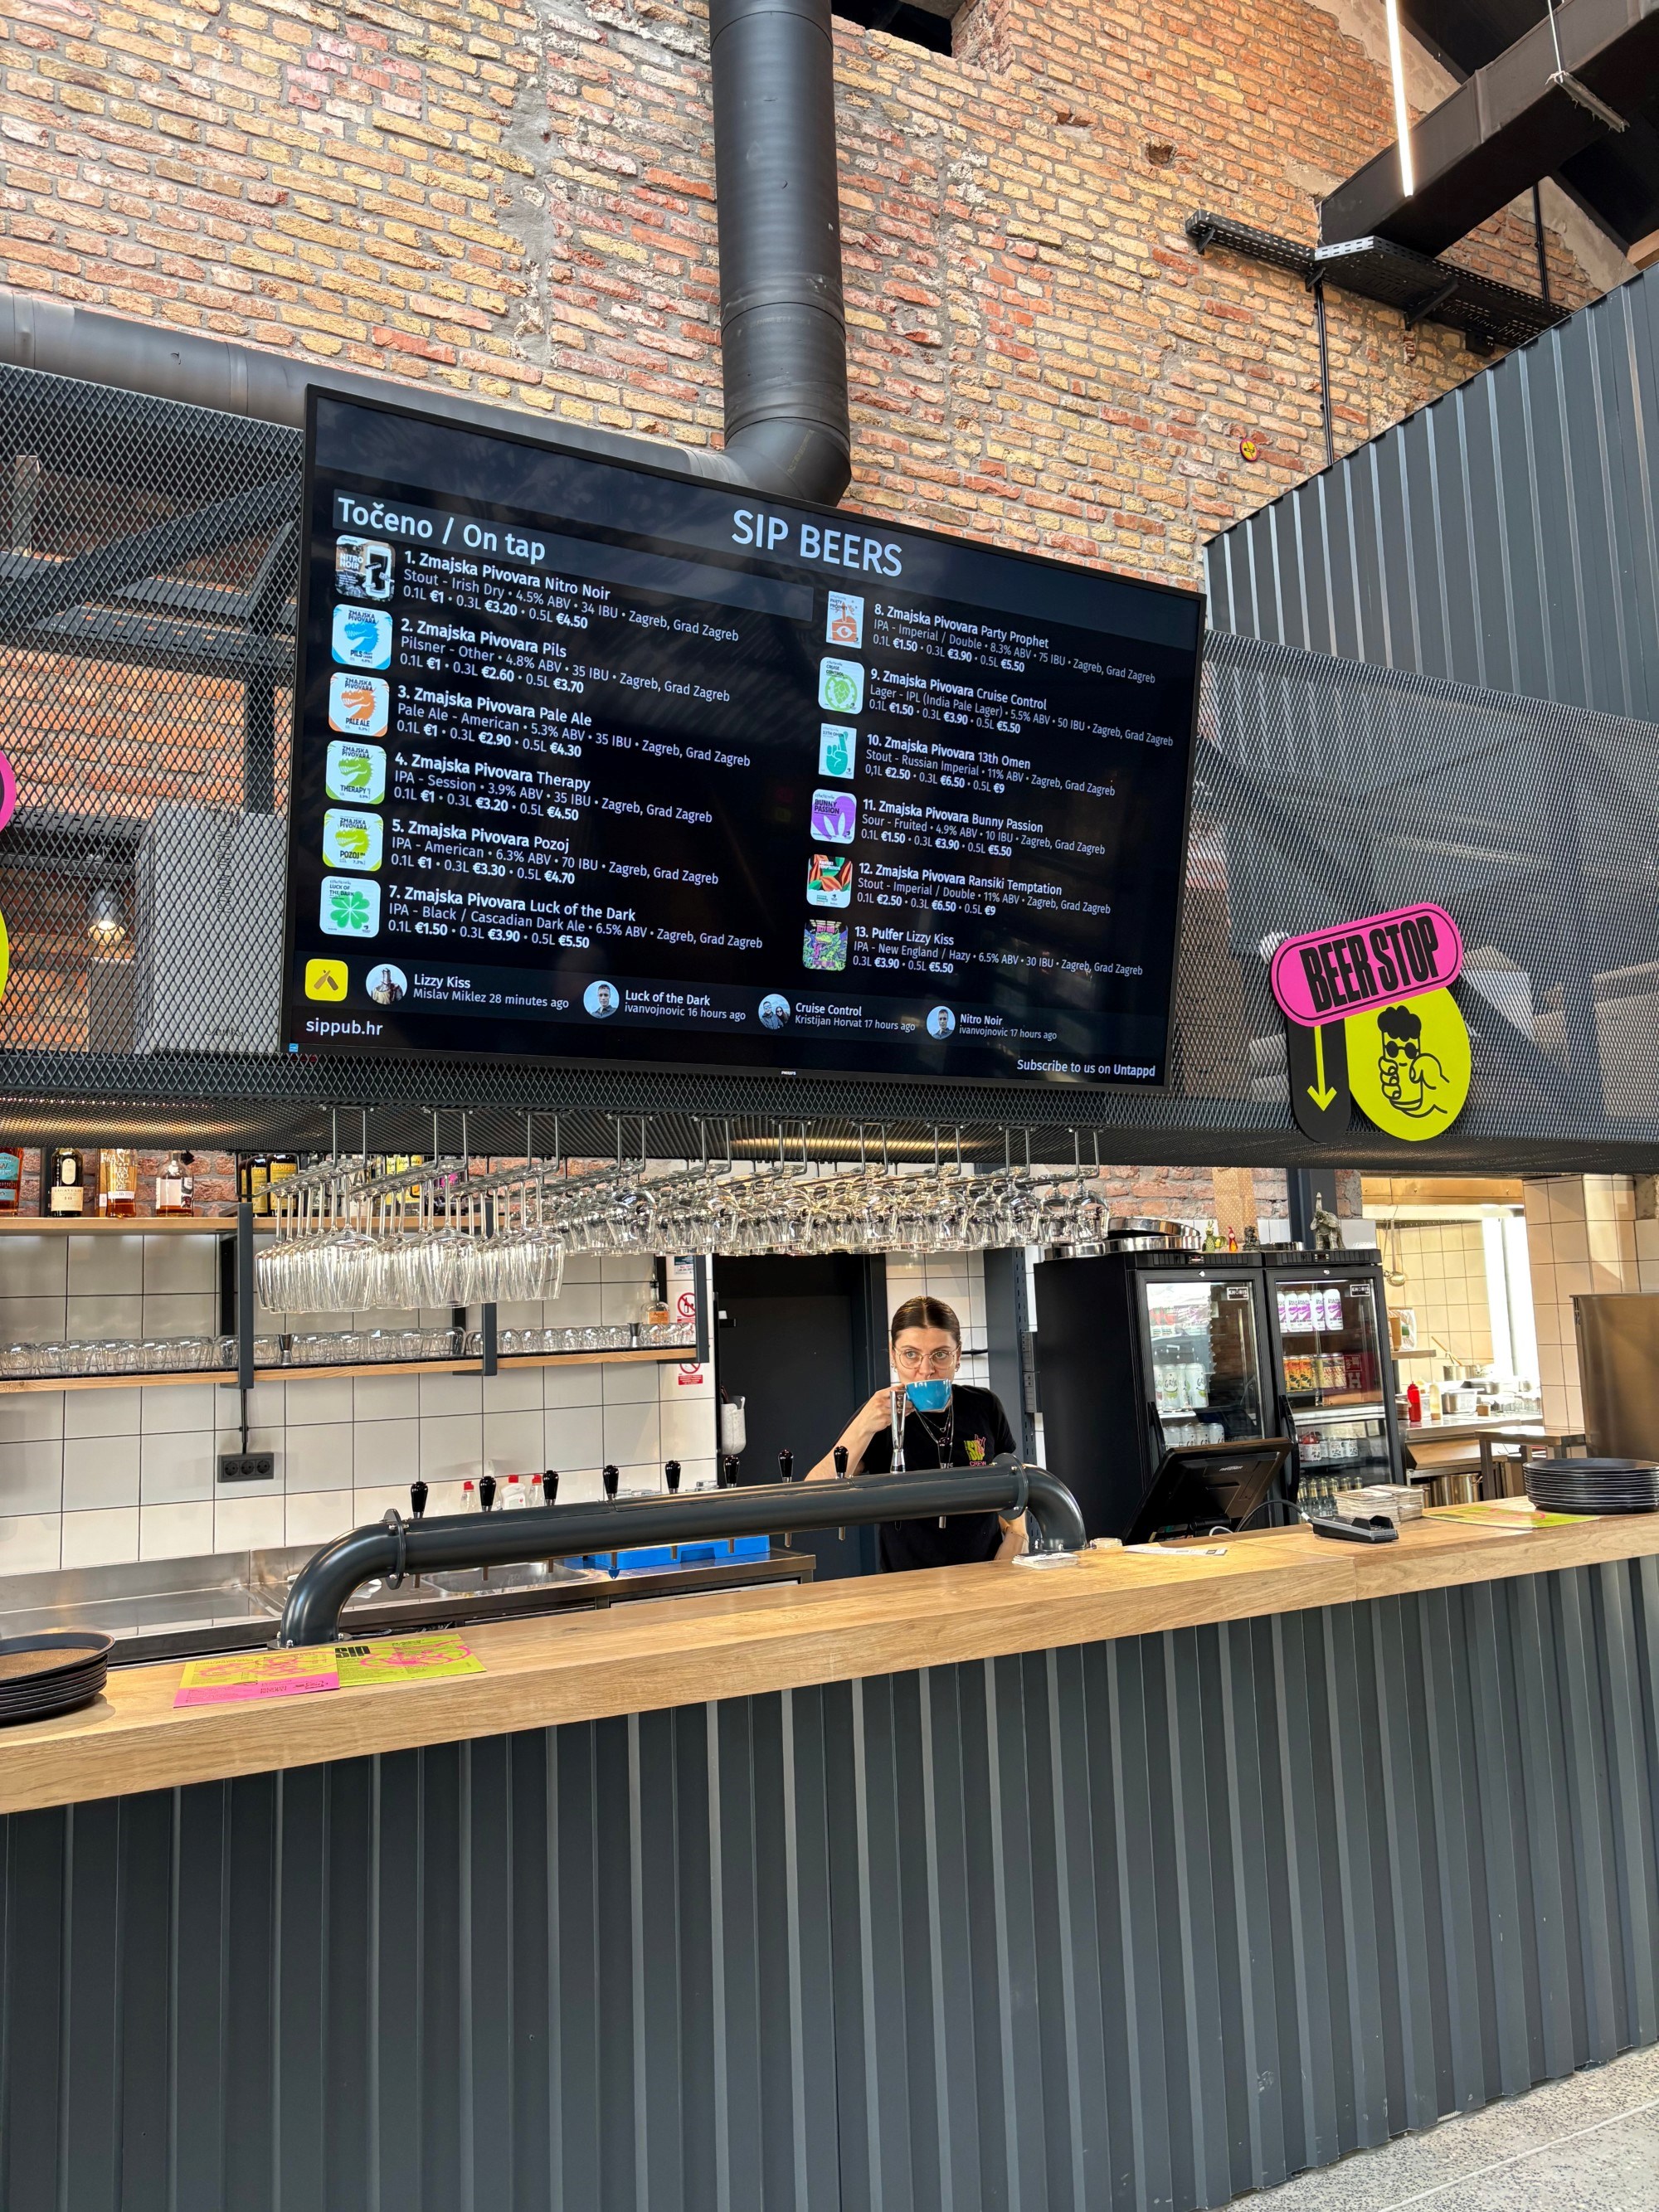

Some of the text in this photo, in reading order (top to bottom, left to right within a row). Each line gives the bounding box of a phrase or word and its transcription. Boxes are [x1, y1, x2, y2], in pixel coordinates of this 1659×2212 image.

[338, 497, 433, 538] Točeno
[463, 522, 499, 552] On
[504, 532, 545, 565] tap
[731, 509, 902, 576] SIP BEERS
[340, 552, 363, 564] NITRO
[340, 559, 360, 570] NOIR
[404, 550, 611, 600] 1. Zmajska Pivovara Nitro Noir
[348, 610, 375, 619] ZMAJSKA
[403, 568, 739, 641] Stout Irish Dry 4.5% ABV 34 IBU Zagreb, Grad Zagreb
[874, 603, 1048, 649] 8. Zmajska Pivovara Party Prophet
[401, 617, 567, 658] 2. Zmajska Pivovara Pils
[350, 649, 363, 658] PILS
[345, 677, 372, 686] ZMAJSKA
[870, 668, 1047, 710] 9. Zmajska Pivovara Cruise Control
[397, 684, 591, 727] 3. Zmajska Pivovara Pale Ale
[868, 698, 1020, 734] 0.1L €1.50 0.3L €3.90 0.5L €5.50
[345, 717, 358, 726] PALE
[342, 745, 369, 754] ZMAJSKA
[867, 733, 1030, 770] 10. Zmajska Pivovara 13th Omen
[394, 751, 591, 793] 4. Zmajska Pivovara Therapy
[884, 766, 911, 780] €2.50
[919, 771, 937, 785] 0.3L
[940, 775, 965, 788] €6.50
[973, 780, 991, 792] 0.5L
[993, 782, 1005, 794] €9
[340, 785, 367, 795] THERAPY
[815, 805, 839, 814] PASSION
[863, 798, 1044, 833] 11. Zmajska Pivovara Bunny Passion
[392, 818, 569, 854] 5. Zmajska Pivovara Pozoj
[340, 850, 360, 859] POZOJ
[859, 862, 873, 874] 12.
[875, 863, 919, 880] Zmajska
[922, 868, 966, 885] Pivovara
[968, 874, 1005, 889] Ransiki
[1006, 879, 1062, 895] Temptation
[388, 884, 635, 921] 7. Zmajska Pivovara Luck of the Dark
[854, 926, 954, 946] 13. Pulfer Lizzy Kiss
[1299, 915, 1439, 1014] BEER STOP
[414, 973, 470, 989] Lizzy Kiss
[413, 987, 569, 1010] Mislav Miklez 28 minutes ago
[625, 989, 710, 1006] Luck of the Dark
[625, 1001, 746, 1023] ivanvojnovic 16 hours ago
[795, 1002, 862, 1016] Cruise Control
[960, 1013, 1003, 1026] Nitro Noir
[305, 1017, 383, 1037] sippub.hr
[795, 1014, 917, 1033] Kristijan Horvat 17 hours ago
[959, 1027, 1058, 1042] ivanvojnovic 17 hours ago
[1017, 1059, 1155, 1078] Subscribe to us on Untappd
